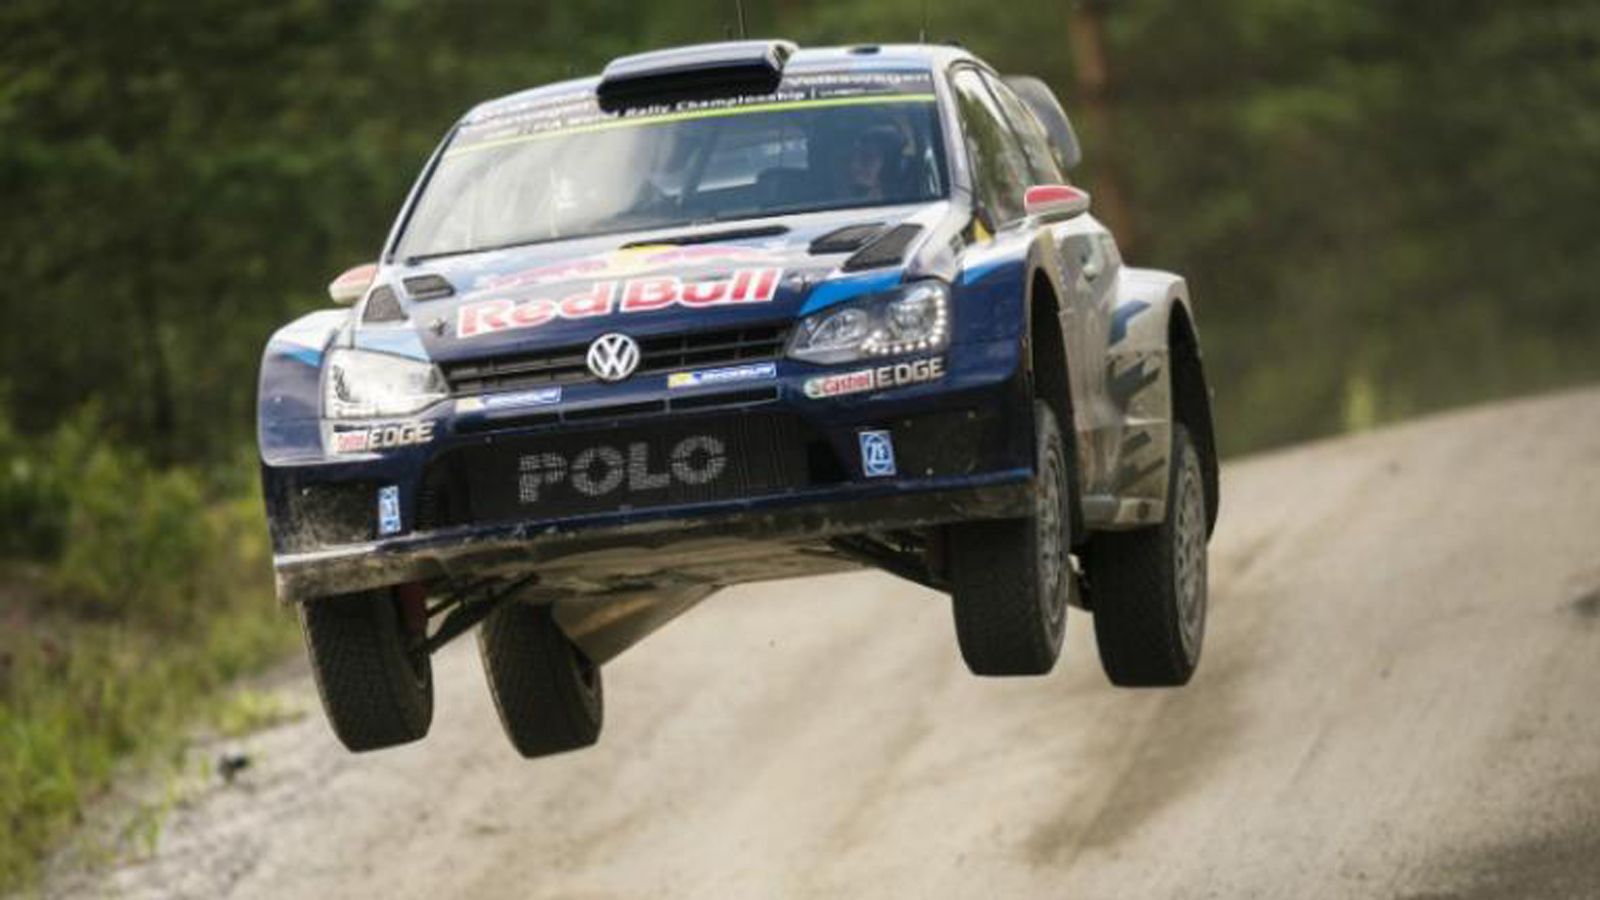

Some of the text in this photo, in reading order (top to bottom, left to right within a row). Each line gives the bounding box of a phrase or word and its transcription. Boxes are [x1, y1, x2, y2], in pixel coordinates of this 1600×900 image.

[624, 104, 670, 119] Rally
[675, 90, 805, 112] Championship
[458, 268, 783, 338] Red Bull
[587, 333, 640, 381] VW
[876, 357, 947, 388] EDGE
[368, 421, 436, 450] EDGE
[518, 435, 727, 503] POLO
